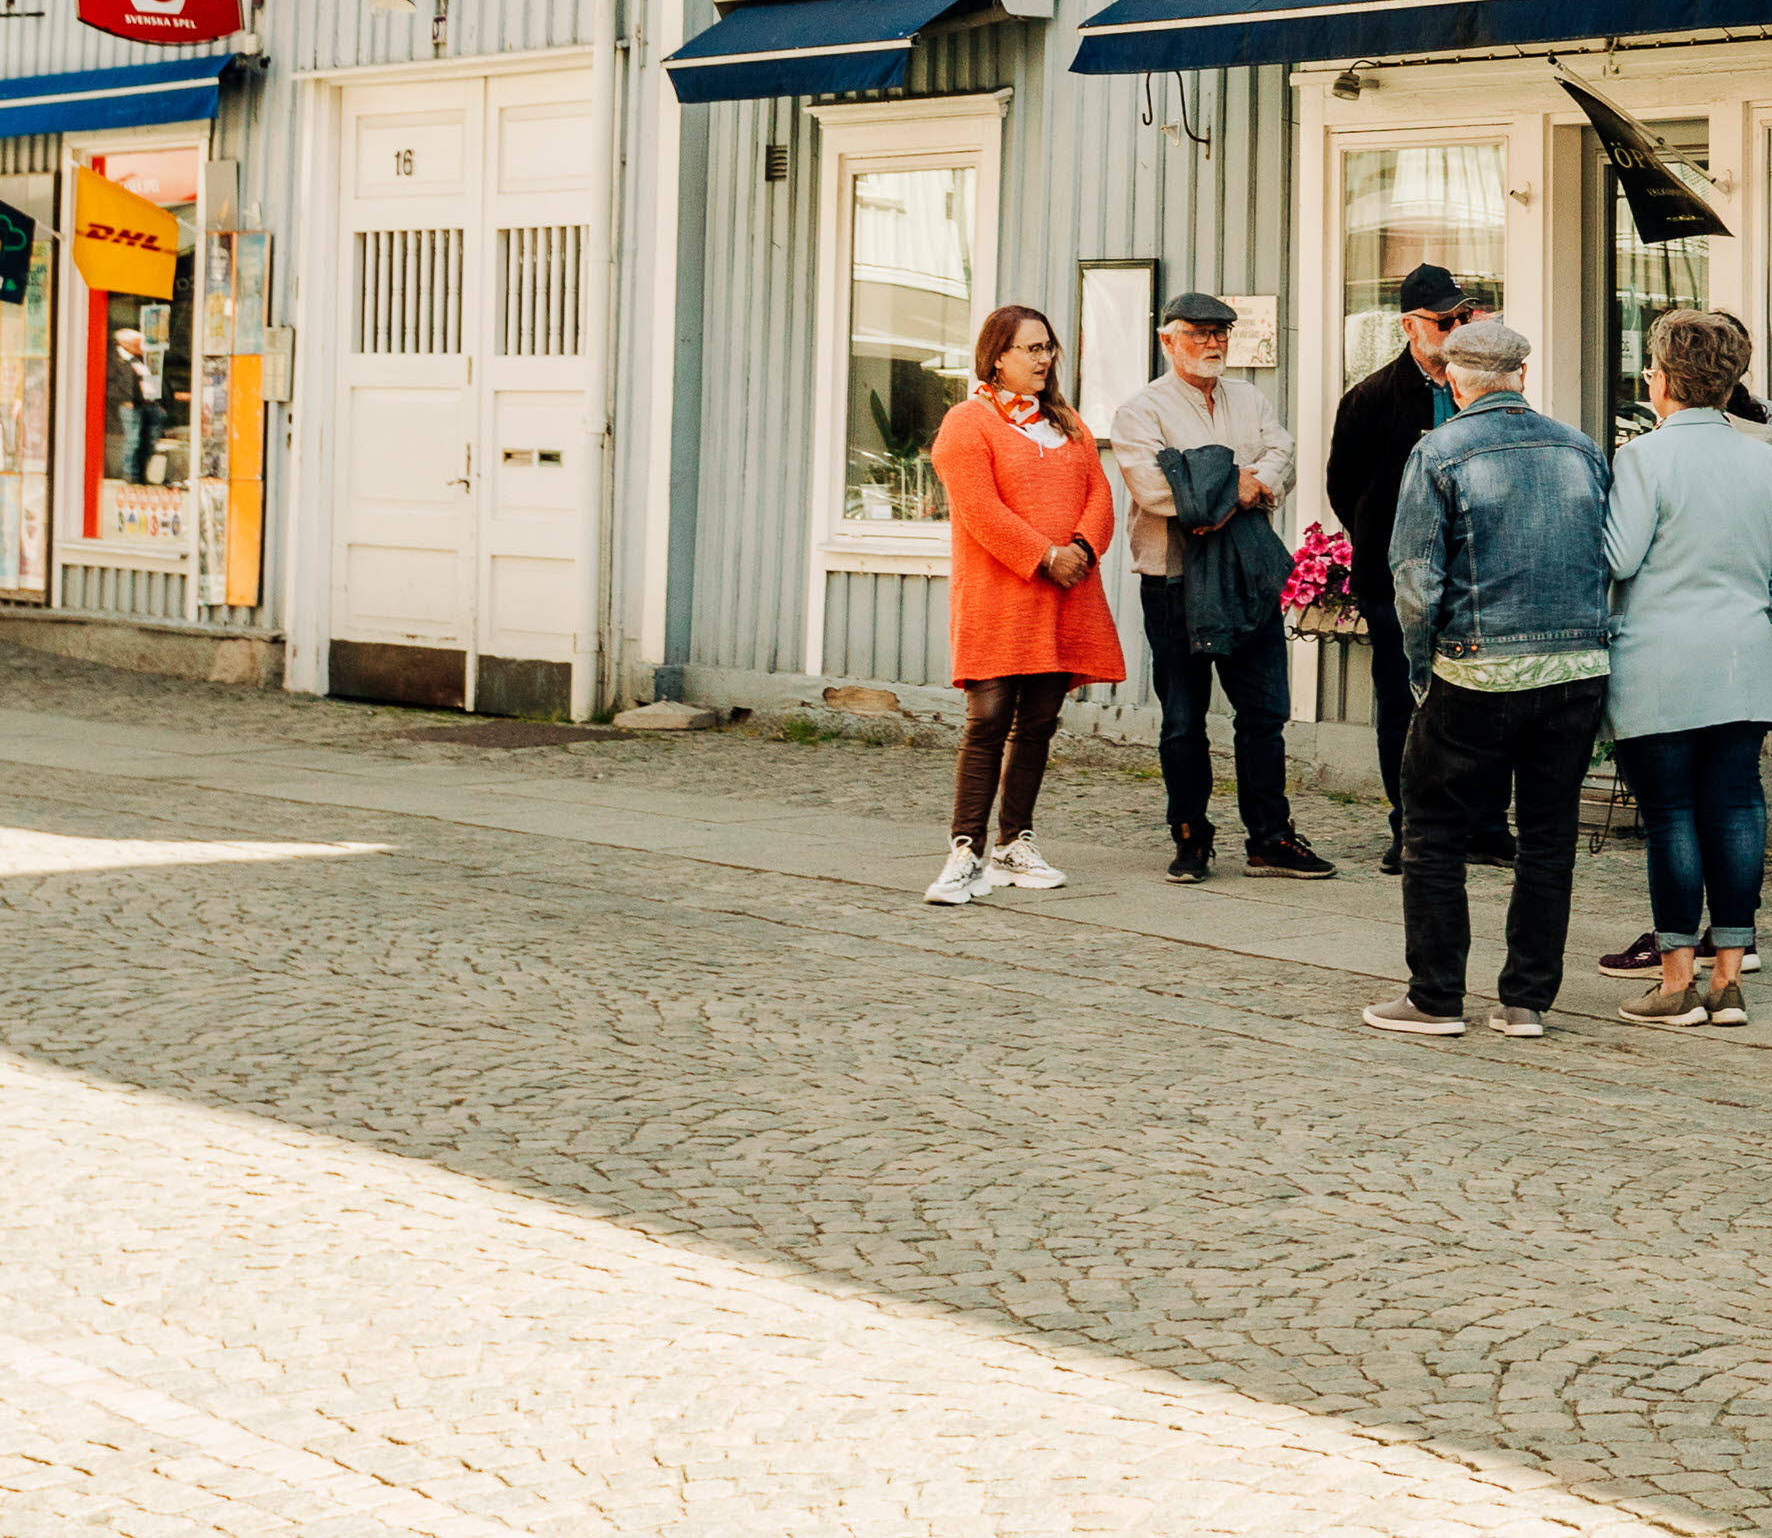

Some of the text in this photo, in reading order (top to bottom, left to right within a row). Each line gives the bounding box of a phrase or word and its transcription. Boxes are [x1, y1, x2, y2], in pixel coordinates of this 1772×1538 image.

[124, 13, 197, 29] SVENSKA SPEL
[394, 148, 413, 176] 16
[85, 222, 161, 252] DHL
